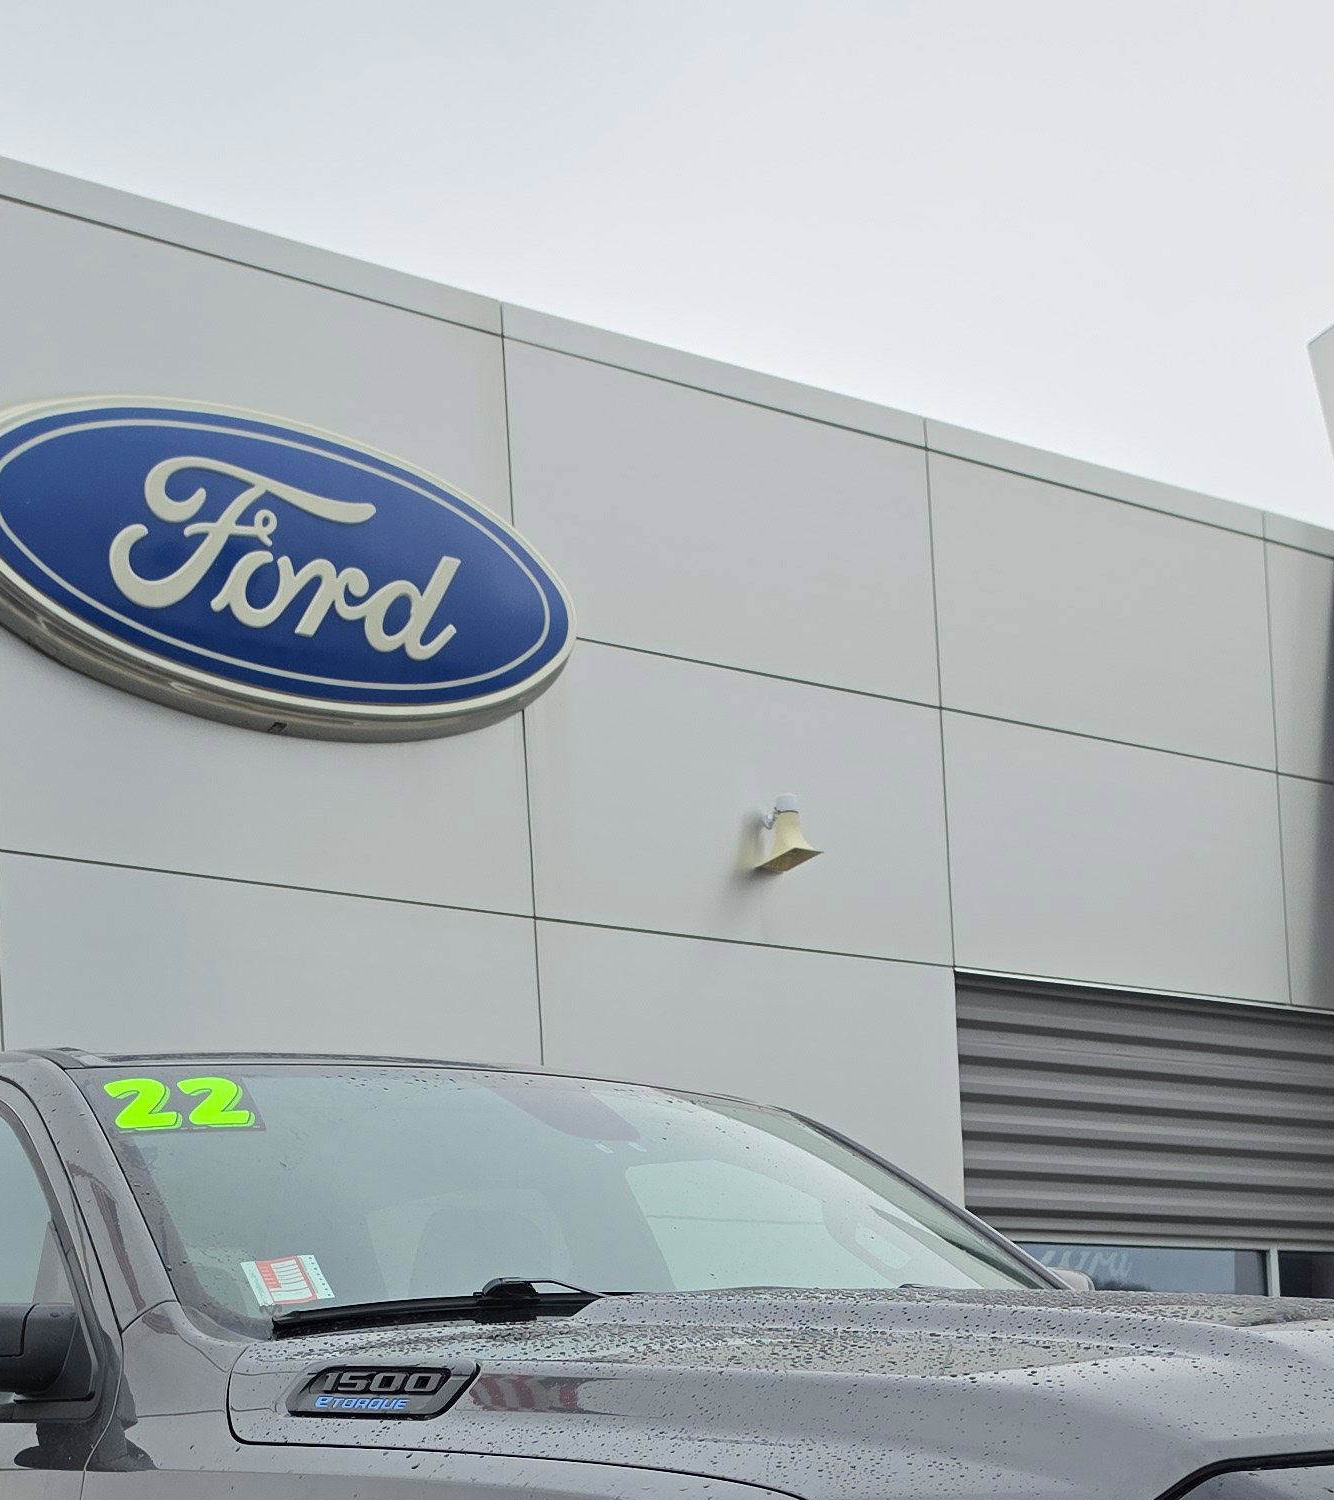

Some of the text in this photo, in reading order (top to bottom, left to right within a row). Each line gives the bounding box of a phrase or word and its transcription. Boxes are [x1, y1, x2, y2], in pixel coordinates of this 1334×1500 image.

[109, 456, 461, 660] Ford
[104, 1077, 256, 1131] 22
[321, 1371, 446, 1394] 1500
